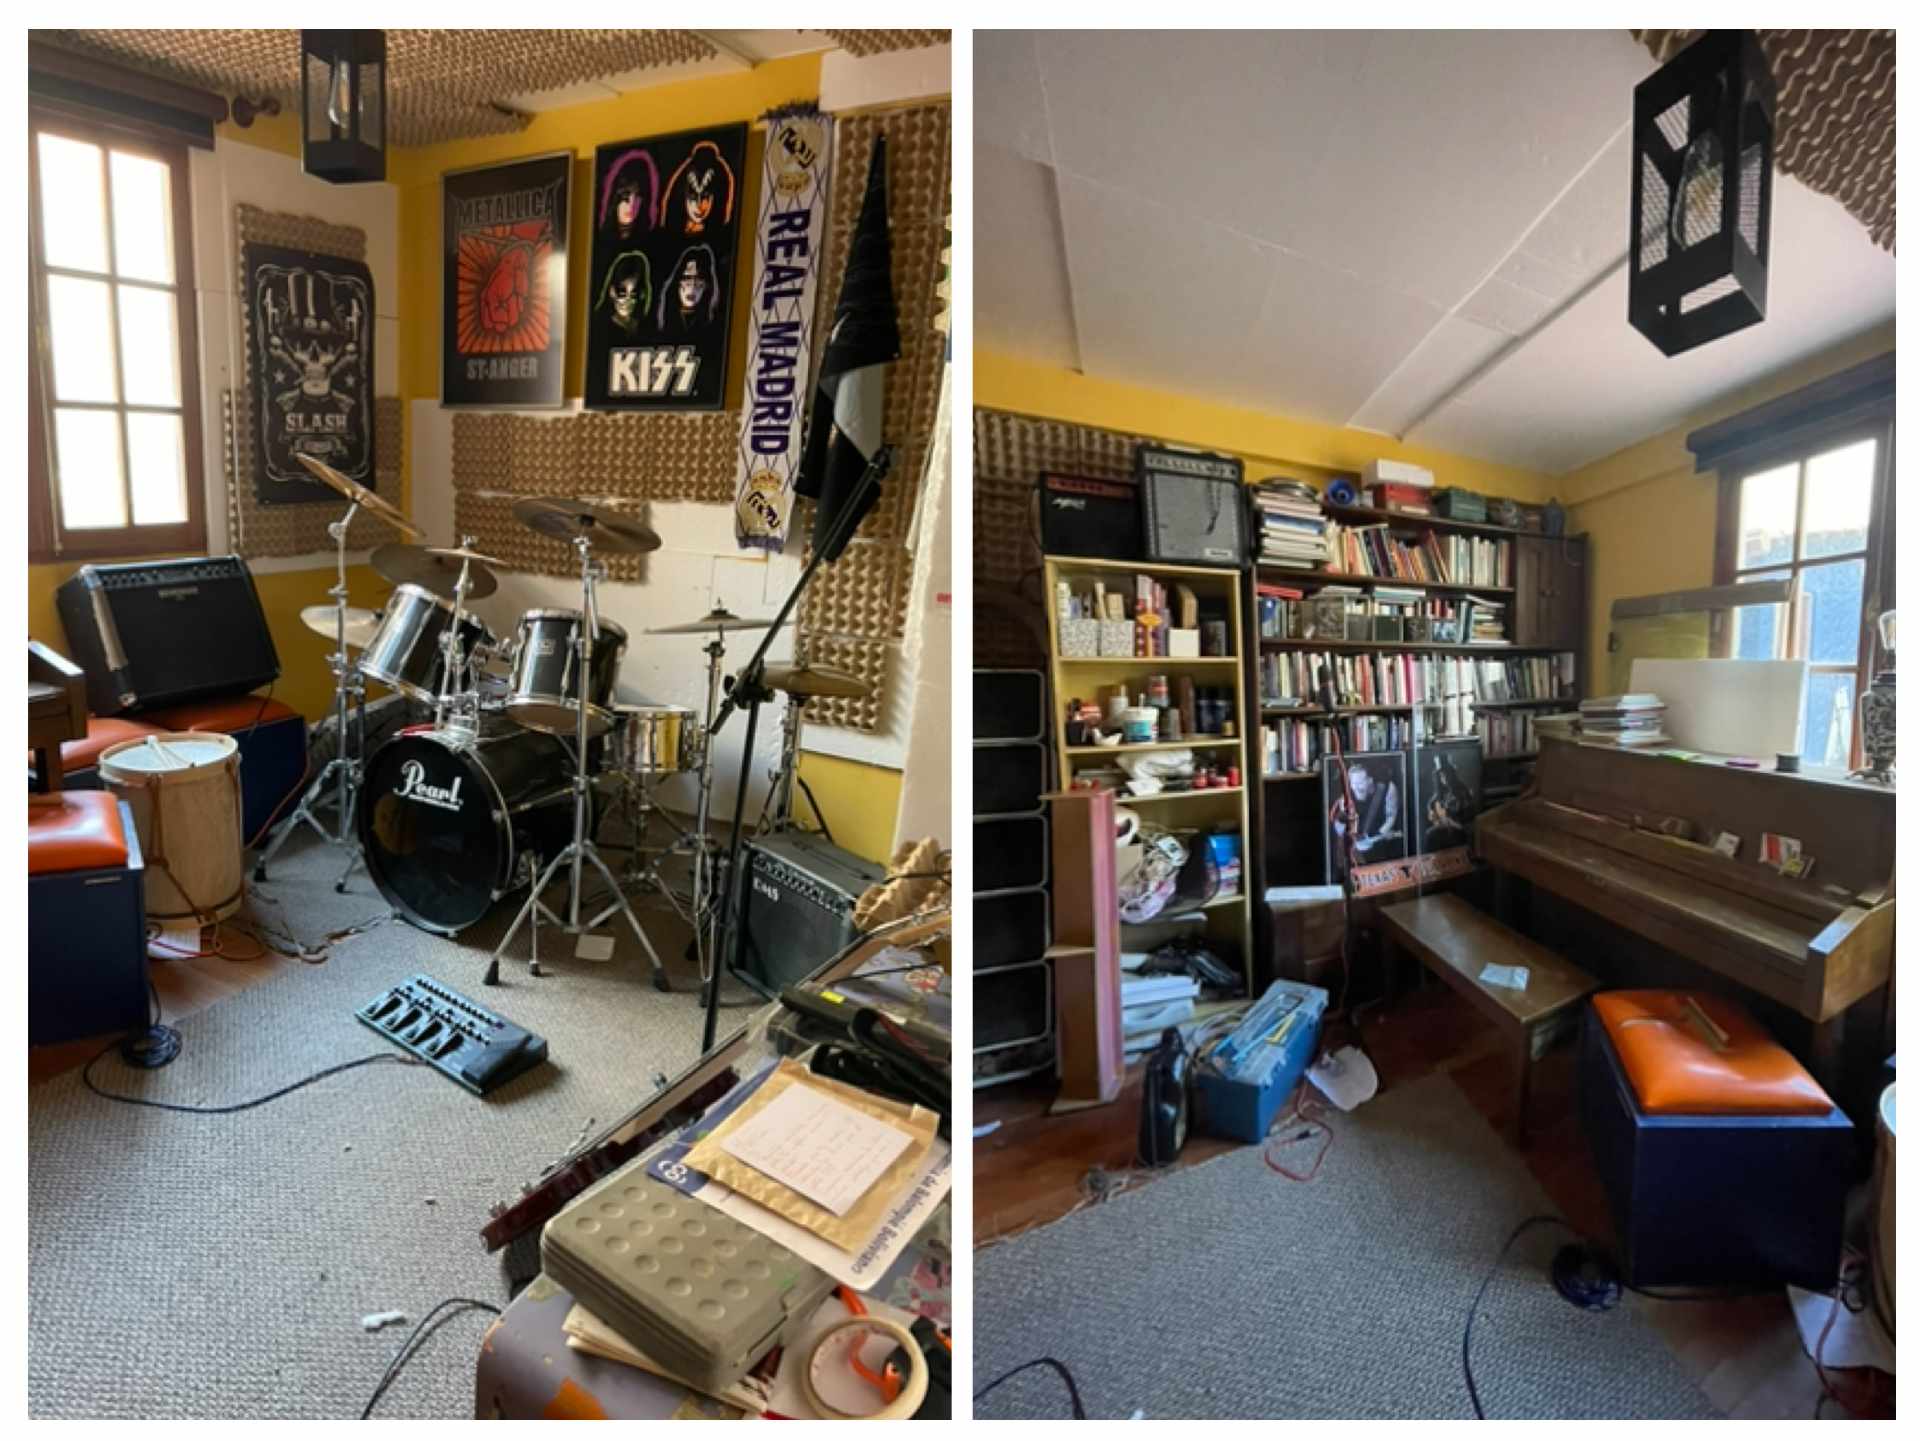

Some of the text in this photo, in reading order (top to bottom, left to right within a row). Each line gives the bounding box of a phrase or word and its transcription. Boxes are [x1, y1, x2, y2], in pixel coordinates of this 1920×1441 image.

[454, 181, 560, 229] METALLICA
[750, 207, 811, 455] REAL MADRID
[608, 345, 702, 397] KISS
[286, 412, 347, 433] SLASH
[392, 759, 463, 808] Pearl
